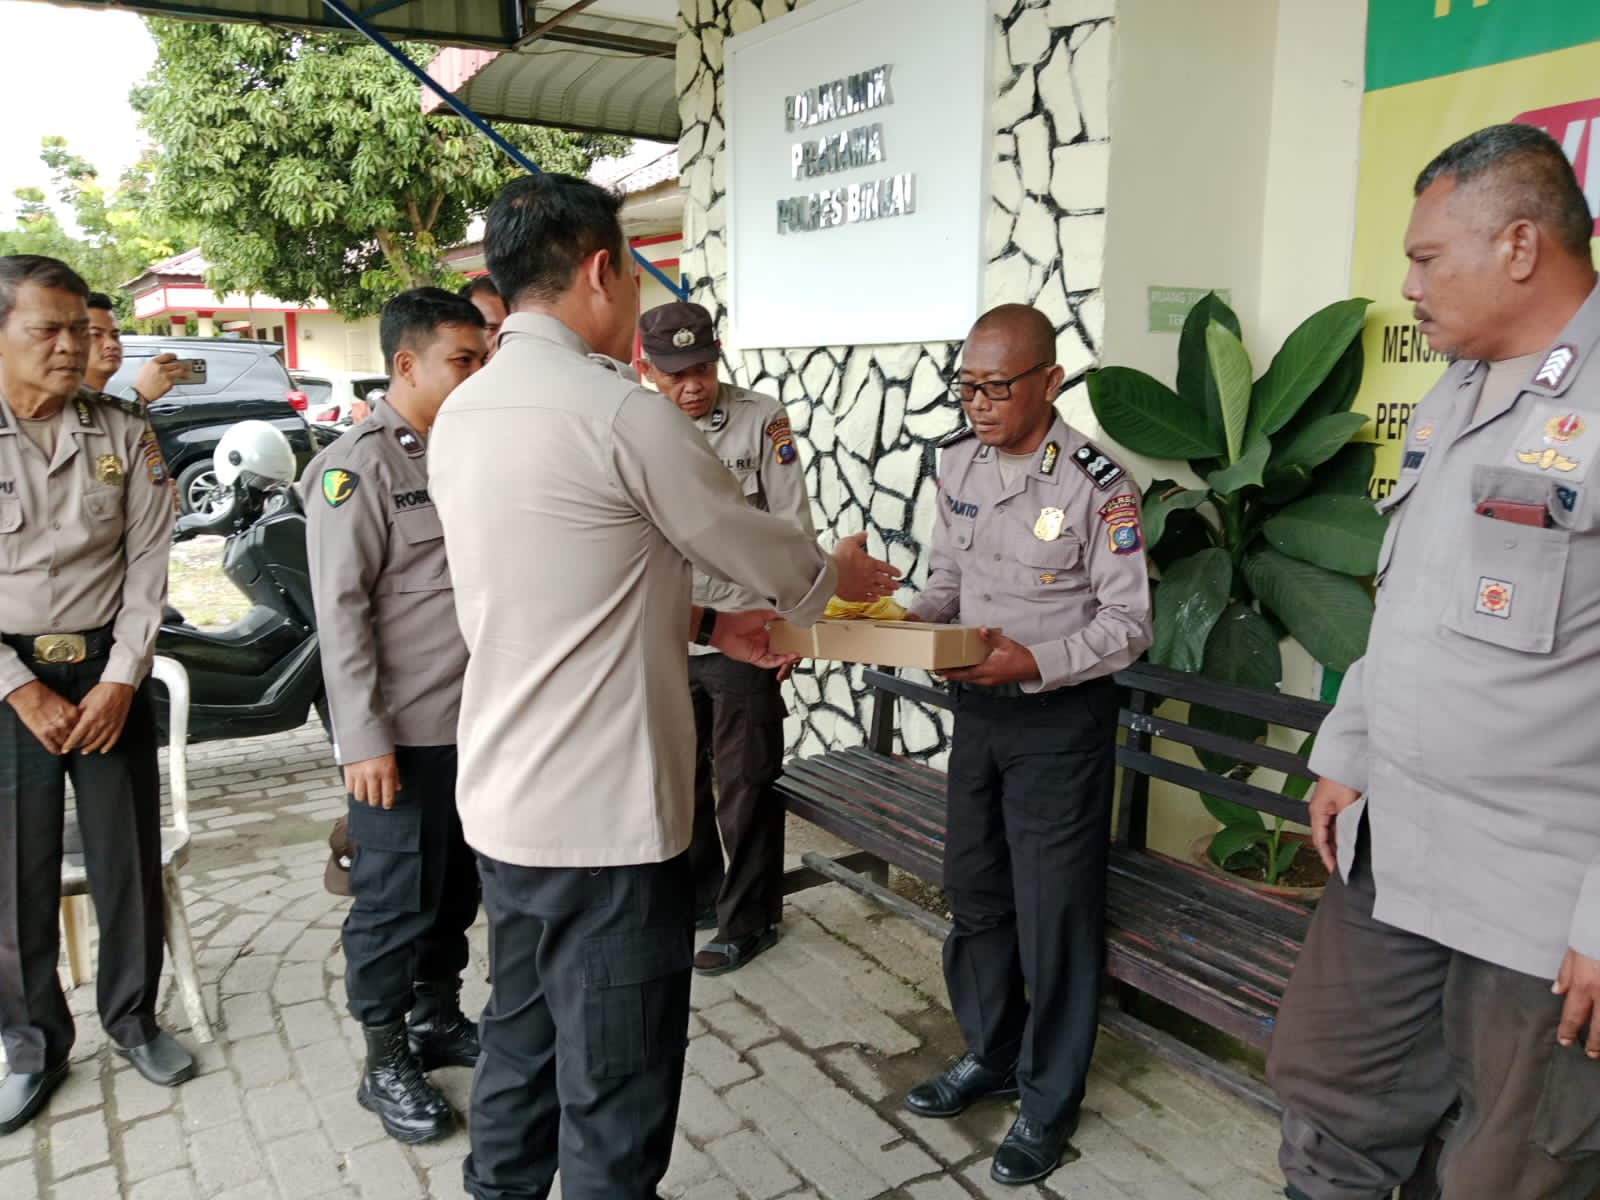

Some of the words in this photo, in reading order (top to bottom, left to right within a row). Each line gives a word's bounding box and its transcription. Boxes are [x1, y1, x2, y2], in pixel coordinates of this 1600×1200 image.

[791, 123, 883, 180] PRATAMA
[777, 187, 845, 233] POLRES
[847, 172, 916, 222] BINJAI
